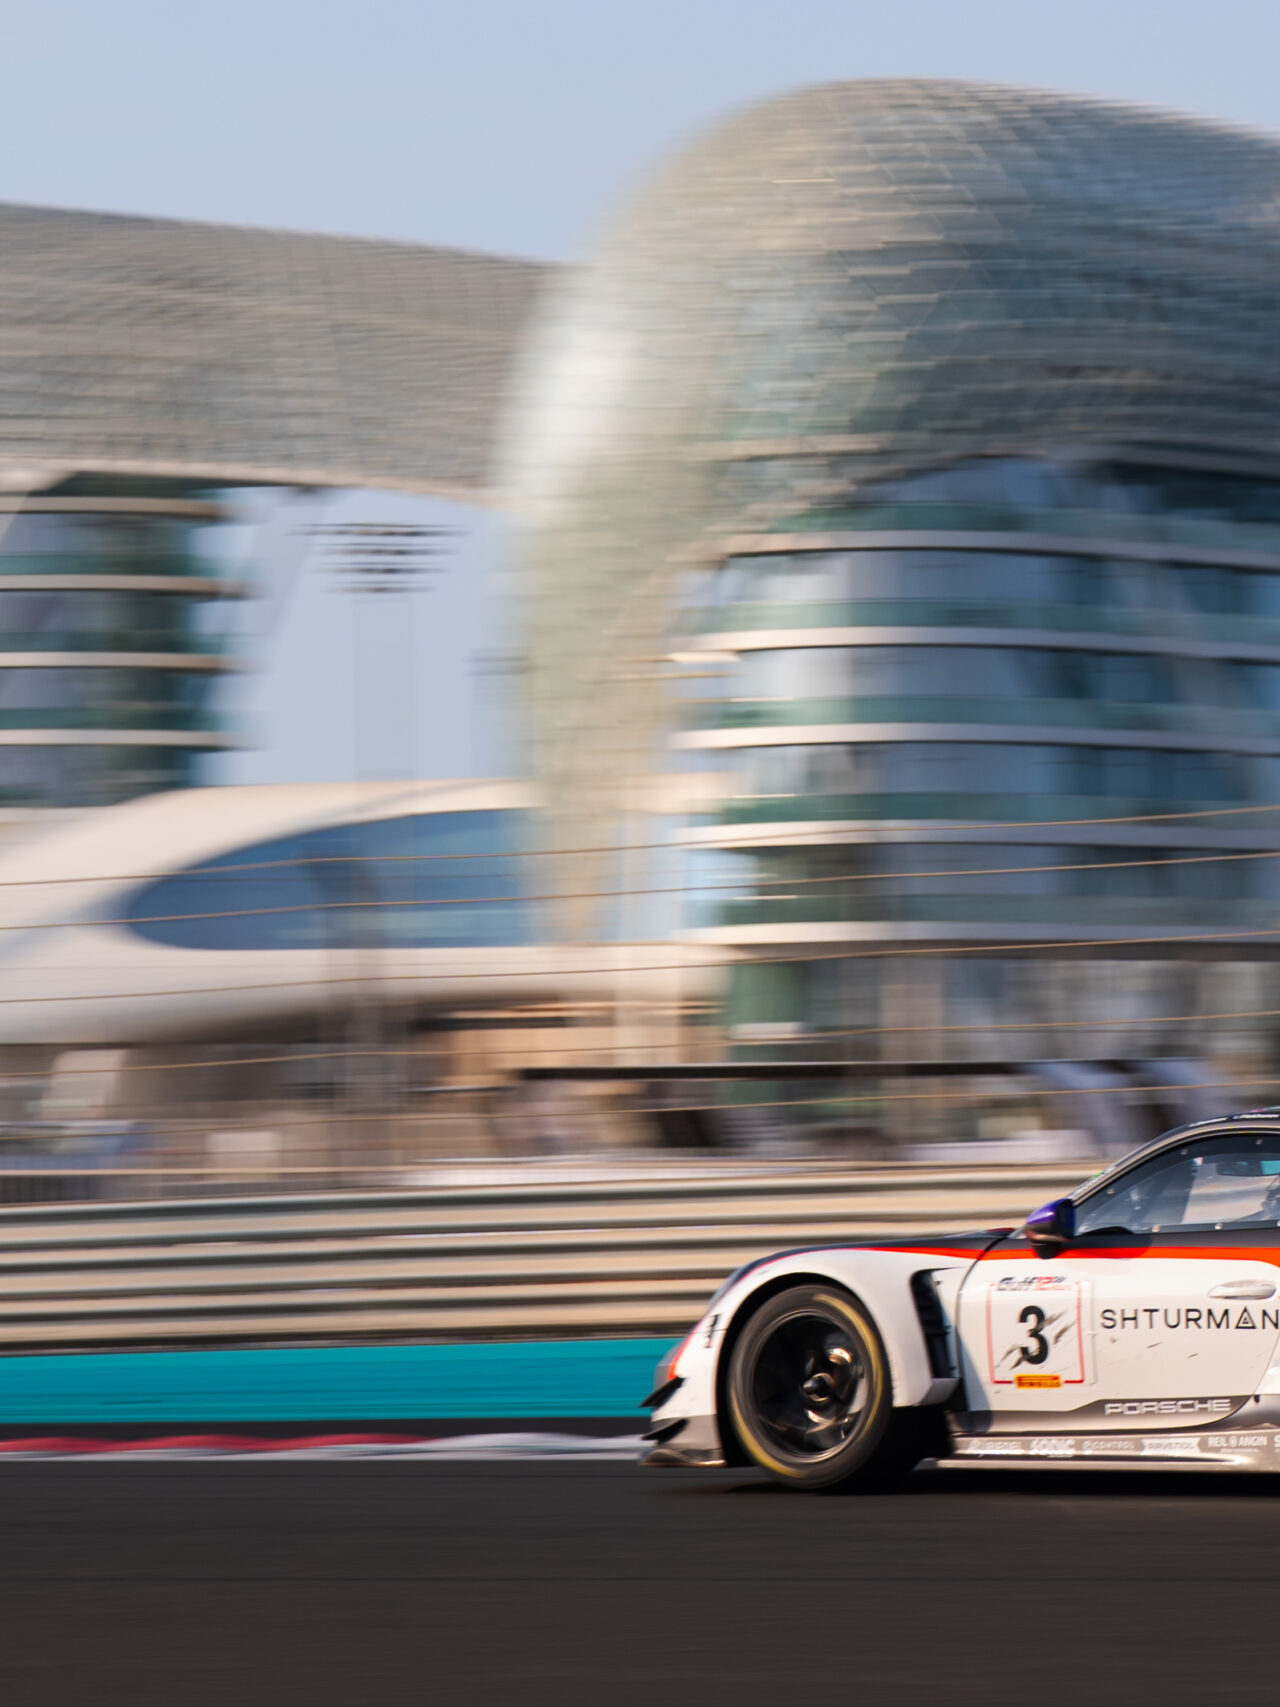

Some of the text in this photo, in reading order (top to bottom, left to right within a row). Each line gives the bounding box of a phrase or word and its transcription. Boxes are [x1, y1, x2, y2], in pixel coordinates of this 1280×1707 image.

[1101, 1306, 1280, 1330] SHTURMAN
[1018, 1305, 1048, 1365] 3
[1104, 1399, 1232, 1416] PORSCHE
